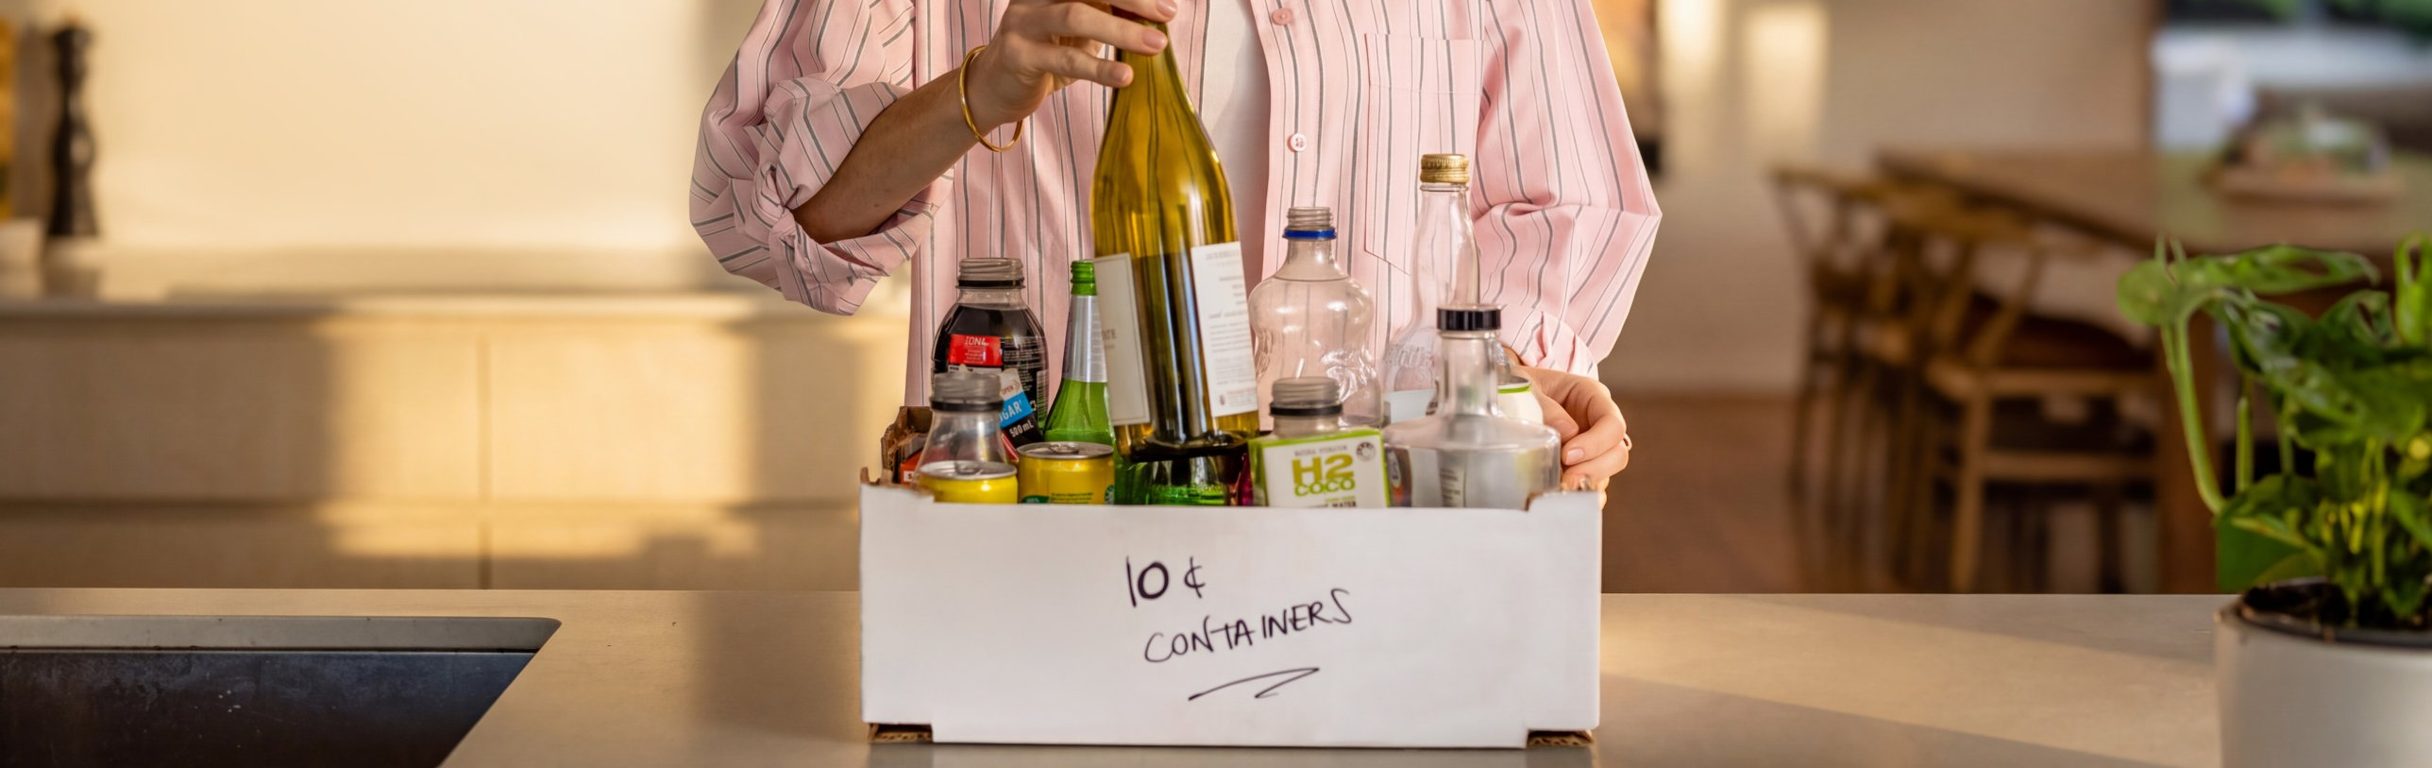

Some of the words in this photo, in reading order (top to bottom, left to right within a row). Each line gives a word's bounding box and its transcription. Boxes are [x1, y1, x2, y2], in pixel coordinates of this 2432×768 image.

[1292, 453, 1354, 487] H2
[1295, 477, 1356, 496] COCO
[1126, 555, 1170, 608] 10
[1144, 588, 1352, 663] CONTAINERS
